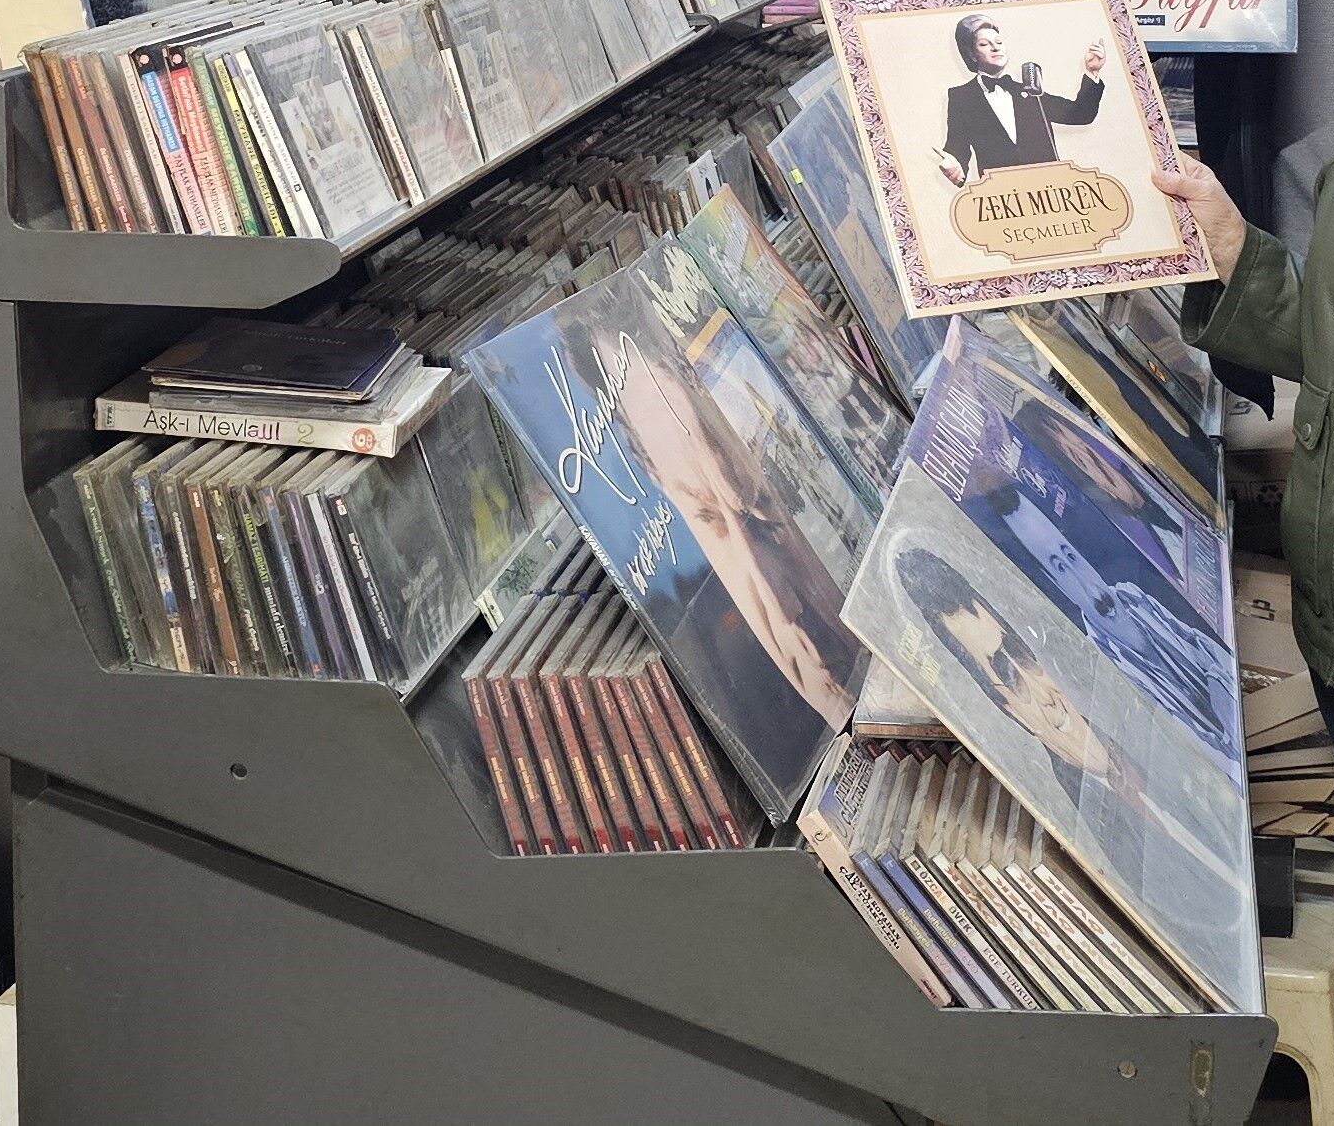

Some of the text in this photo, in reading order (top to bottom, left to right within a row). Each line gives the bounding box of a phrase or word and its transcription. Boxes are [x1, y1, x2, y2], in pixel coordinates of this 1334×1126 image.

[973, 181, 1118, 224] ZEKİ MÜREN
[1002, 218, 1097, 245] SEÇMELER
[143, 410, 315, 446] Aşk-ı 2
[558, 331, 689, 505] Kayahan
[922, 378, 990, 501] SELAMİ ŞAHİN
[577, 523, 610, 567] KAYAHAN
